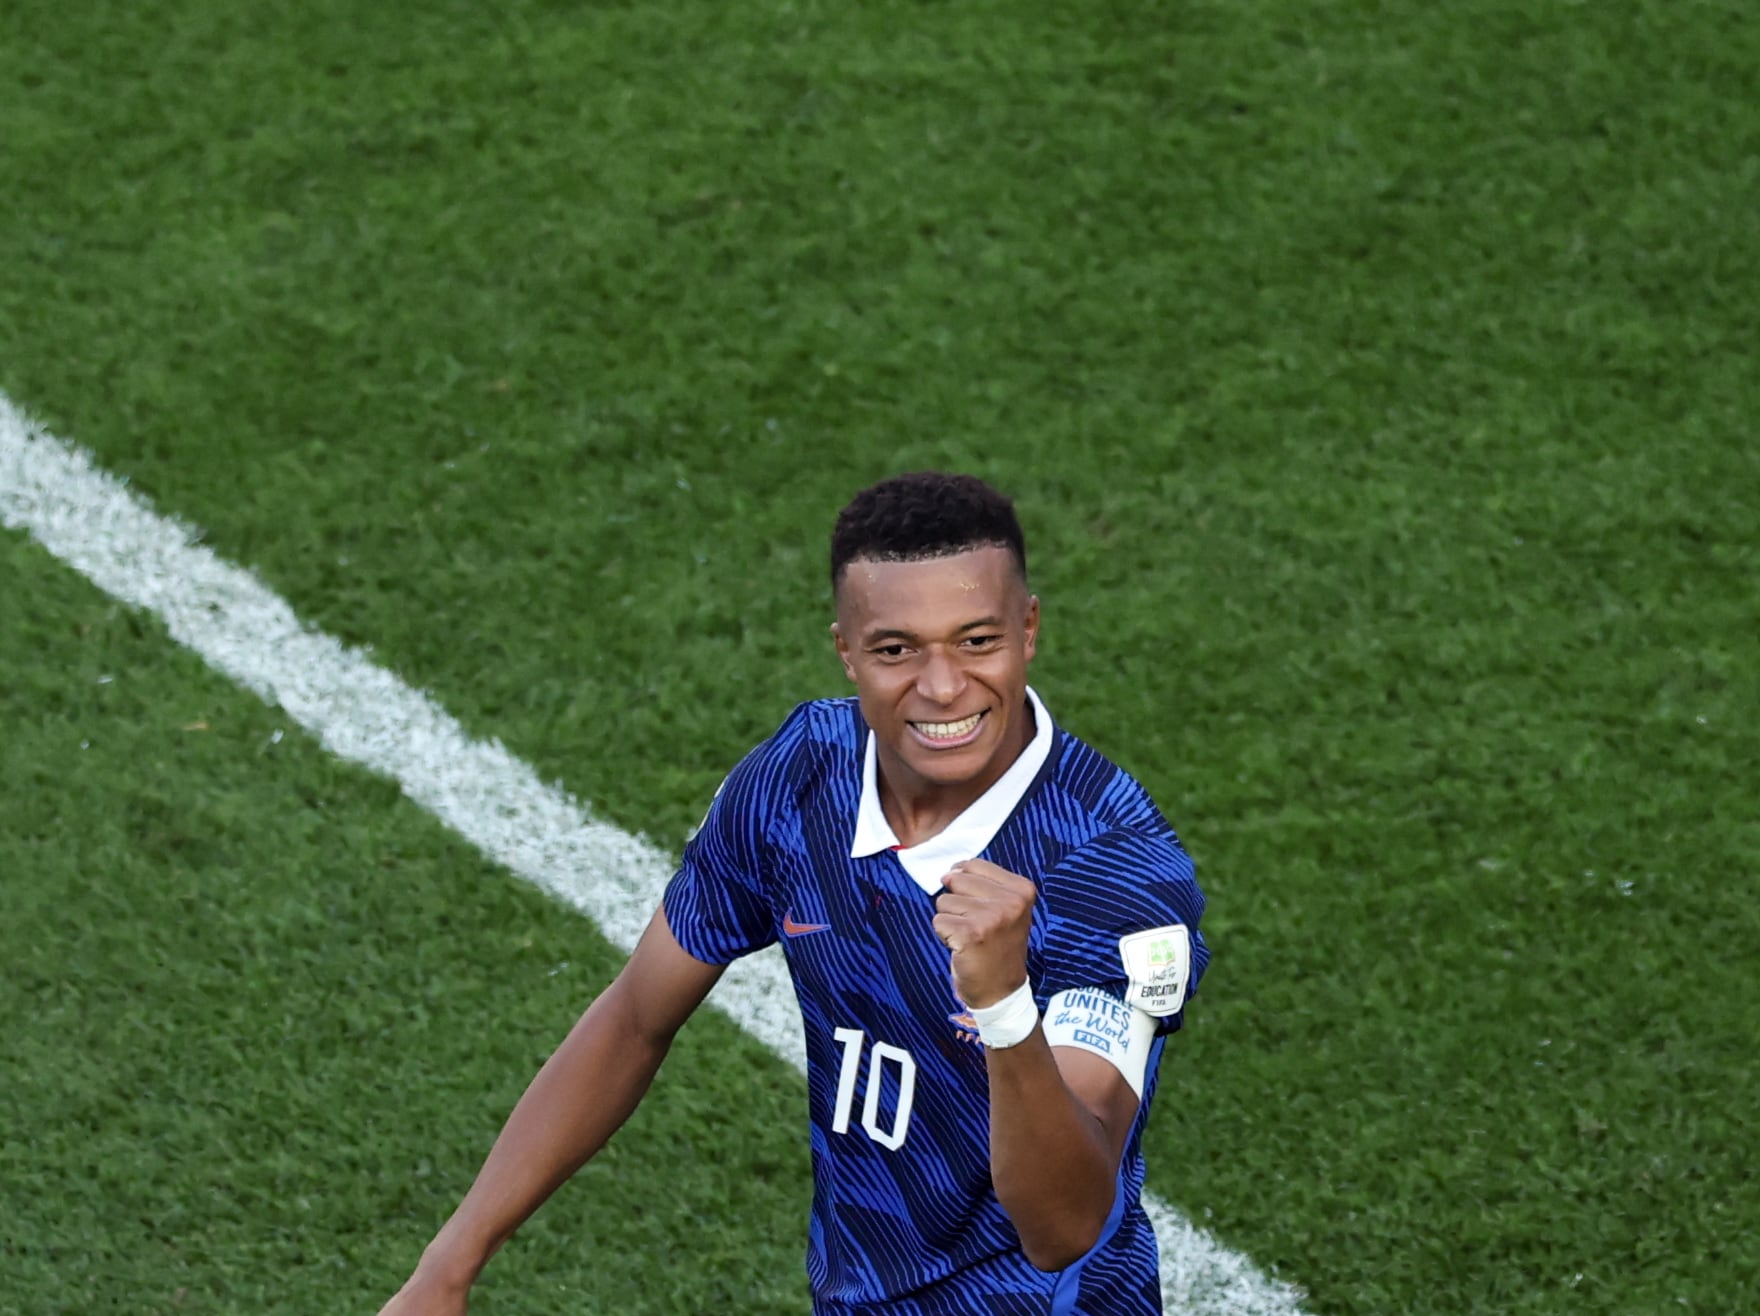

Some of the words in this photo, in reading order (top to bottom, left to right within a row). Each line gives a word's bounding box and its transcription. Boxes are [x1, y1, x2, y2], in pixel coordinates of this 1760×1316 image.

[1140, 982, 1179, 998] EDUCATION
[1063, 992, 1131, 1031] UNITES
[1054, 1009, 1083, 1027] the
[1085, 1012, 1131, 1054] World
[1075, 1030, 1110, 1053] FIFA
[832, 1026, 917, 1152] 10
